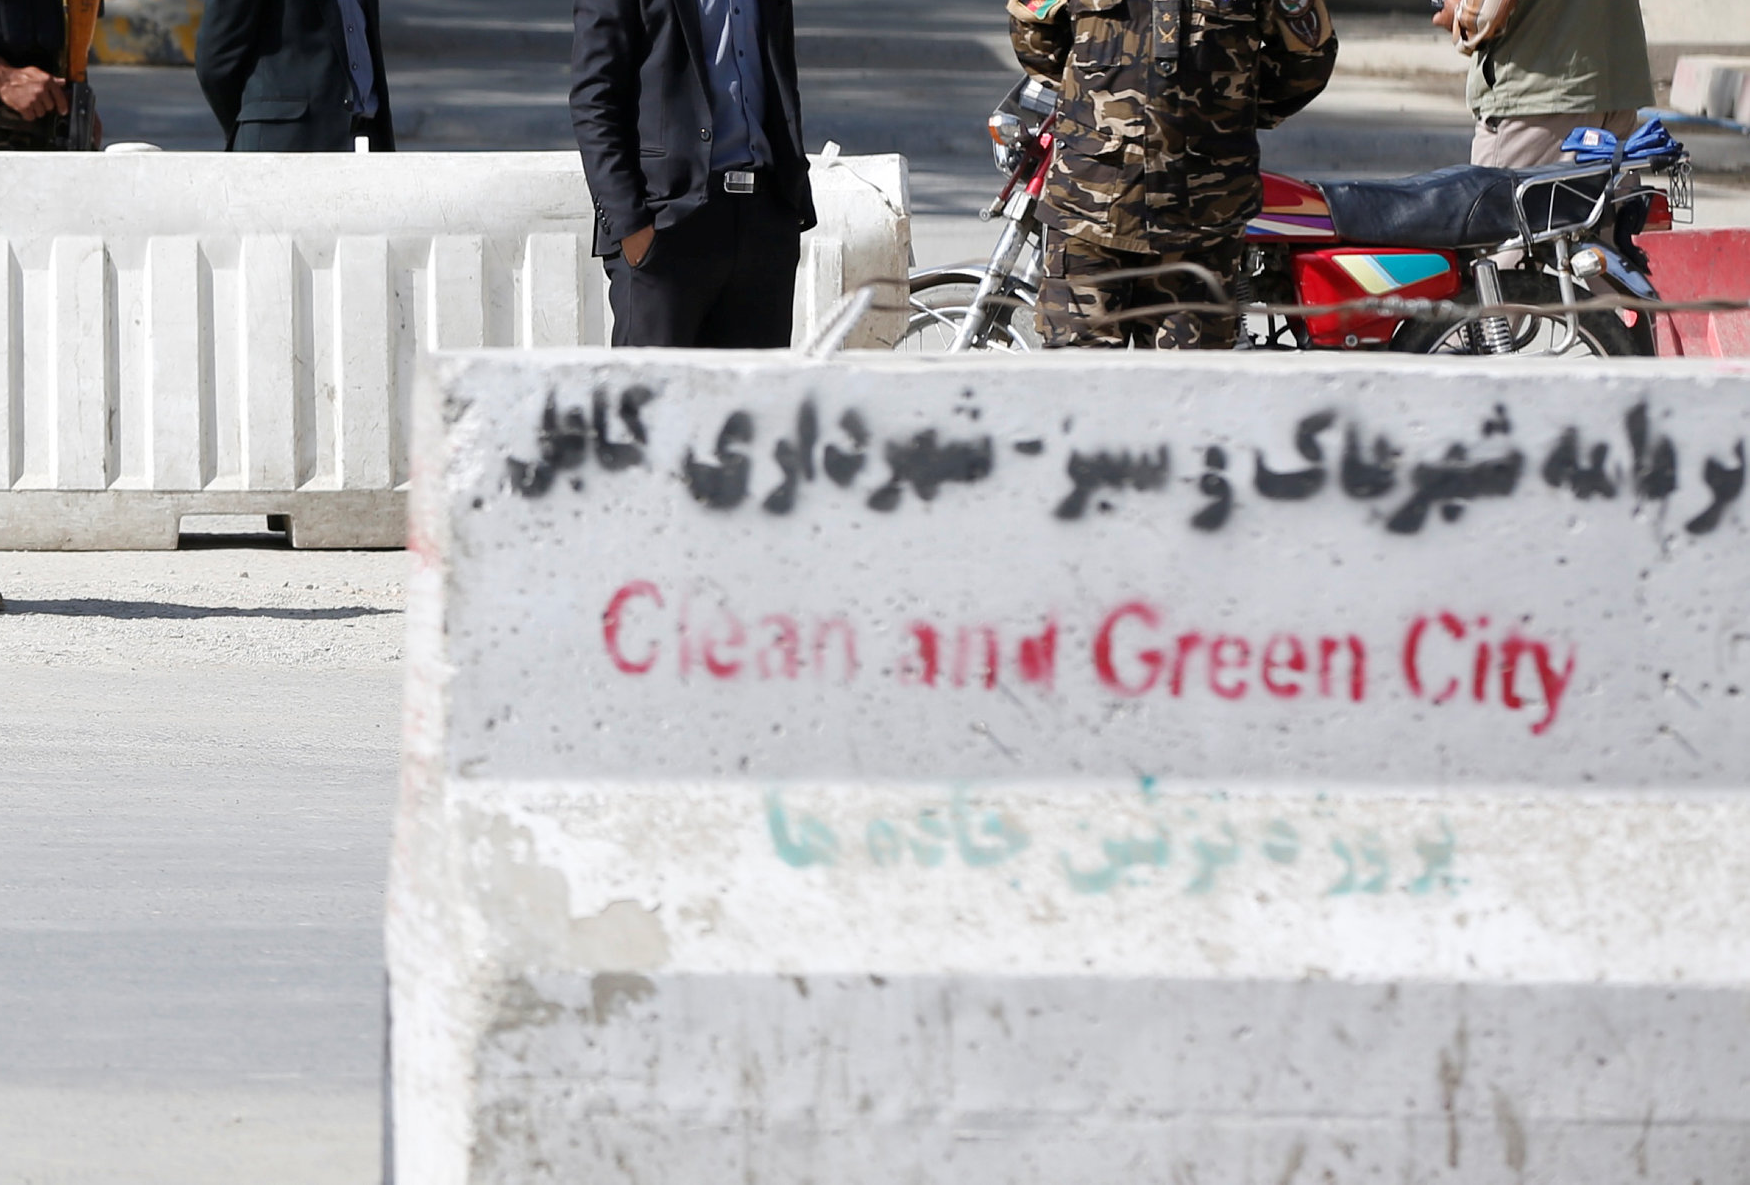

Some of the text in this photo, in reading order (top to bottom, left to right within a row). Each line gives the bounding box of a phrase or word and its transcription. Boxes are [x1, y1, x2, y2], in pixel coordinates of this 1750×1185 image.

[601, 579, 1576, 736] Clean and Green City
